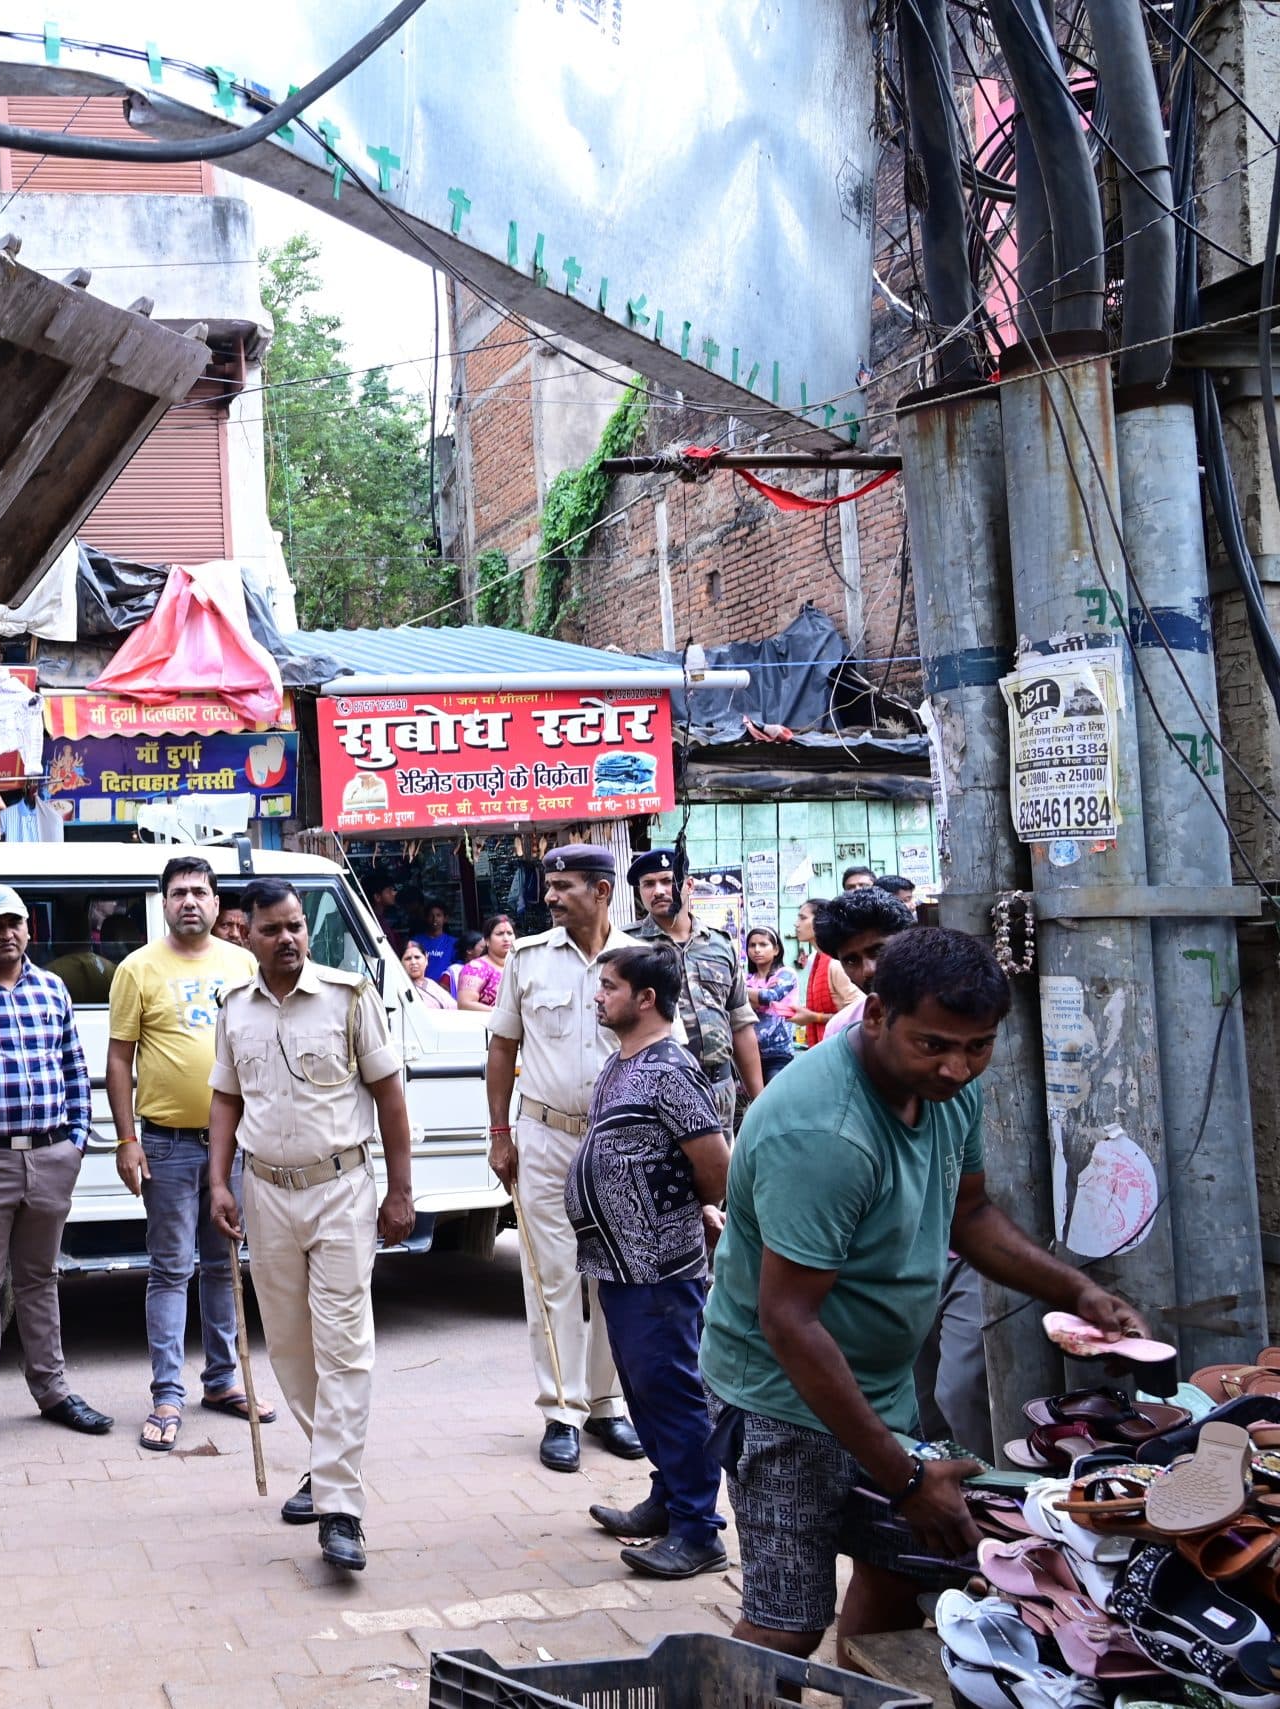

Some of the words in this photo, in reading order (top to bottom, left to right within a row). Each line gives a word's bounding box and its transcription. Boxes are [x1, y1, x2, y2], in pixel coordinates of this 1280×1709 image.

[457, 697, 477, 705] जय
[499, 693, 539, 704] शीतला
[90, 706, 106, 726] माँ
[111, 706, 137, 729] दुर्गा
[142, 705, 197, 722] दिलबहार
[1031, 710, 1050, 725] दूध
[1052, 722, 1074, 735] करने
[1076, 722, 1086, 732] के
[1088, 720, 1106, 732] लिए
[333, 704, 512, 770] सुबोध
[531, 696, 658, 747] स्टोर
[135, 742, 159, 763] माँ
[165, 740, 202, 769] दुर्गा
[1023, 743, 1108, 760] 8235461384
[100, 770, 181, 793] दिलबहार
[186, 769, 237, 791] लस्सी
[397, 768, 453, 795] रेडिमेड
[509, 764, 529, 789] के
[534, 762, 590, 791] विक्रेता
[1055, 770, 1065, 782] से
[427, 803, 451, 818] एस.
[456, 799, 475, 816] बी.
[480, 801, 501, 815] राय
[538, 794, 574, 812] देवघर
[1020, 795, 1111, 831] 8235461384
